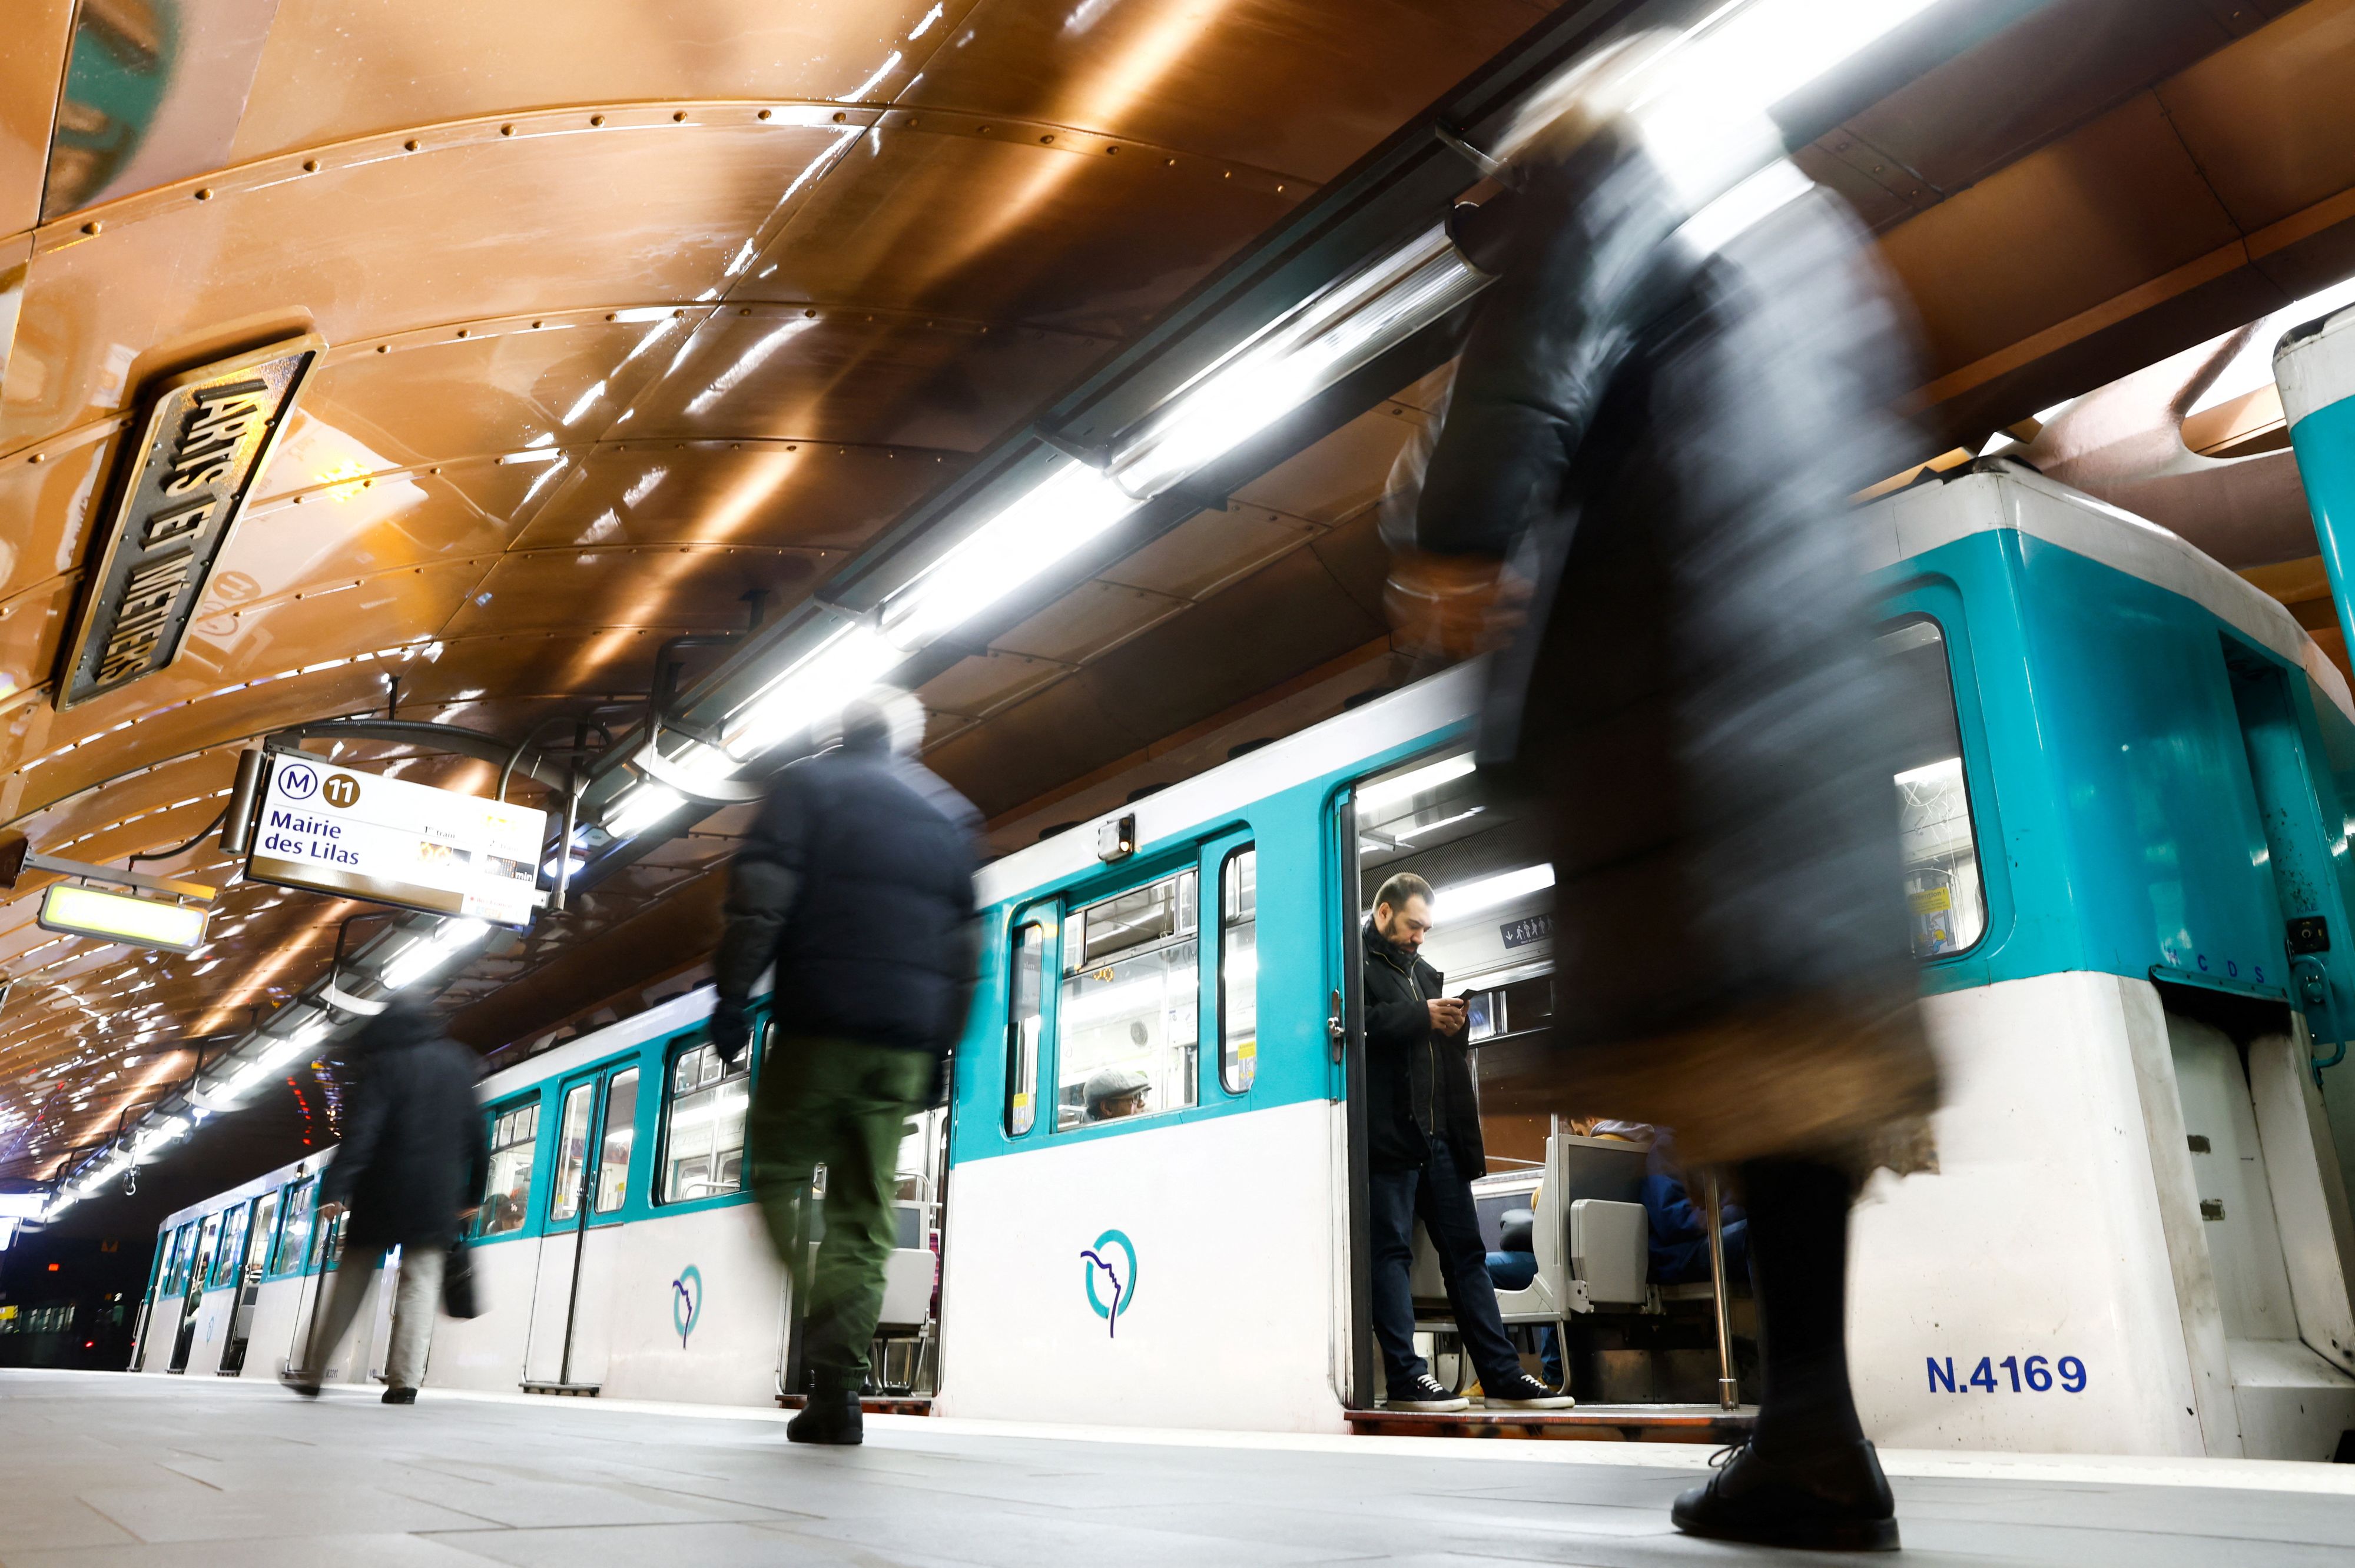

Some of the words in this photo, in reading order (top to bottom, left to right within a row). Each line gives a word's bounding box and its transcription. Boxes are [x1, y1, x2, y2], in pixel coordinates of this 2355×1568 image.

[165, 381, 268, 497] ARTS
[143, 496, 217, 552] ET
[286, 770, 310, 793] M
[329, 778, 354, 803] 11
[270, 810, 341, 839] Mairie
[265, 833, 303, 855] des
[310, 841, 359, 865] Lilas
[2197, 954, 2208, 971] C
[2227, 960, 2237, 978] D
[2254, 966, 2264, 984] S
[1926, 1355, 2087, 1393] N.4169
